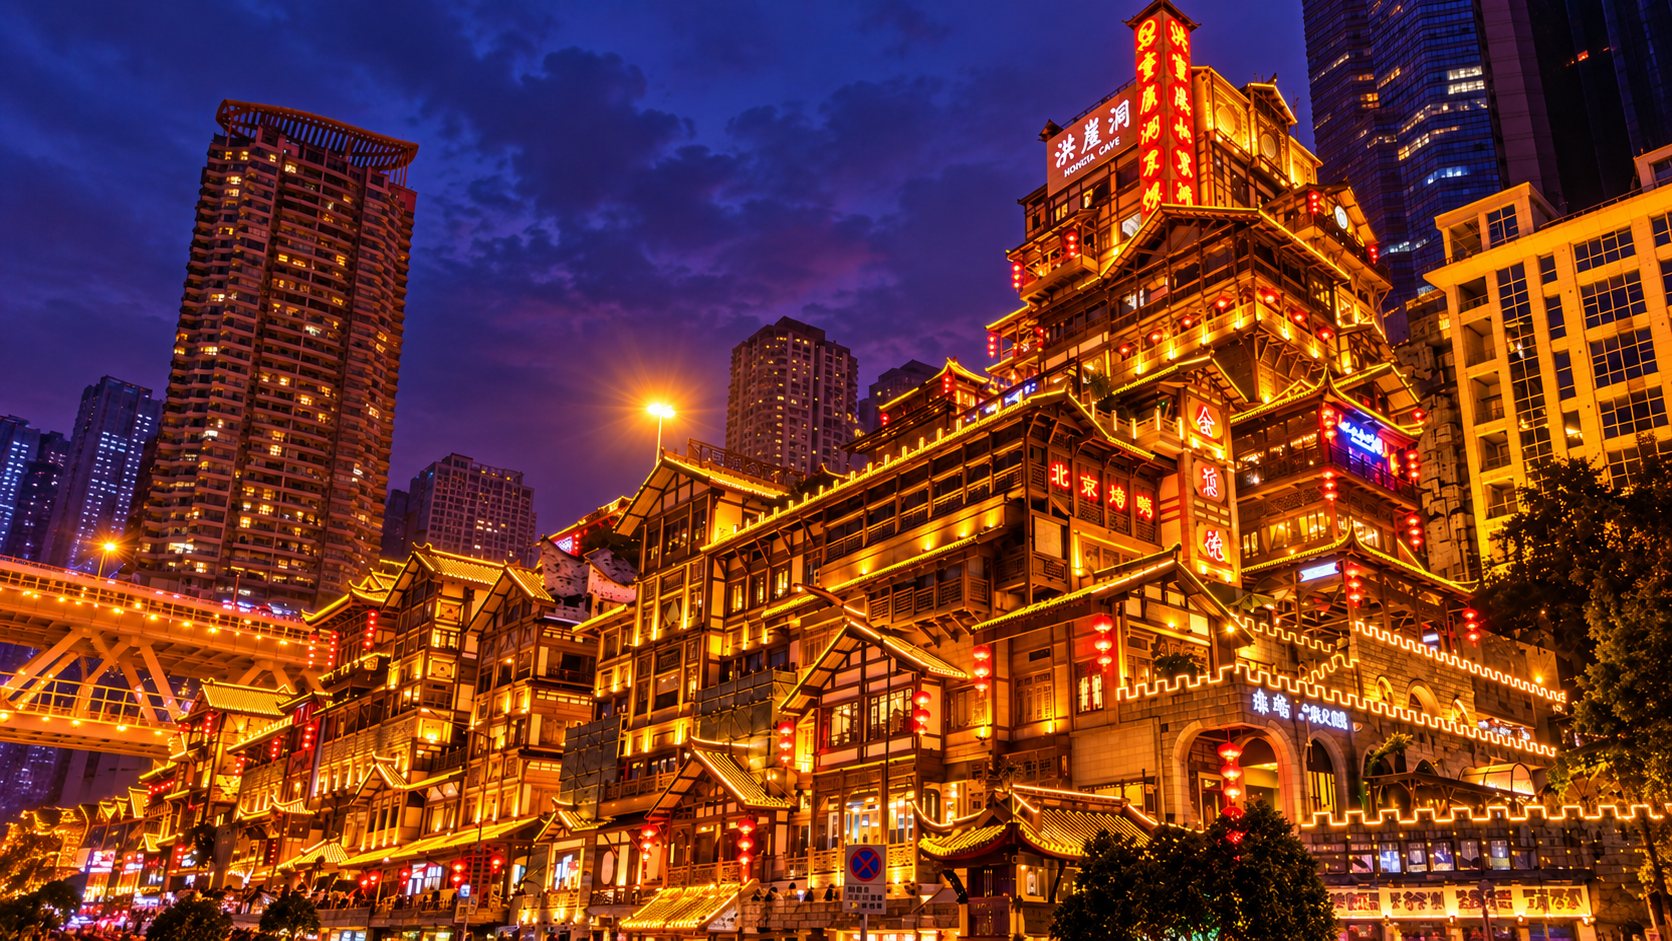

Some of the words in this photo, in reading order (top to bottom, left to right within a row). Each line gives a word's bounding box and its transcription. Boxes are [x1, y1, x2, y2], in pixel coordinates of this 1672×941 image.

[1054, 99, 1130, 169] 洪崖洞
[1098, 136, 1120, 156] CAVE
